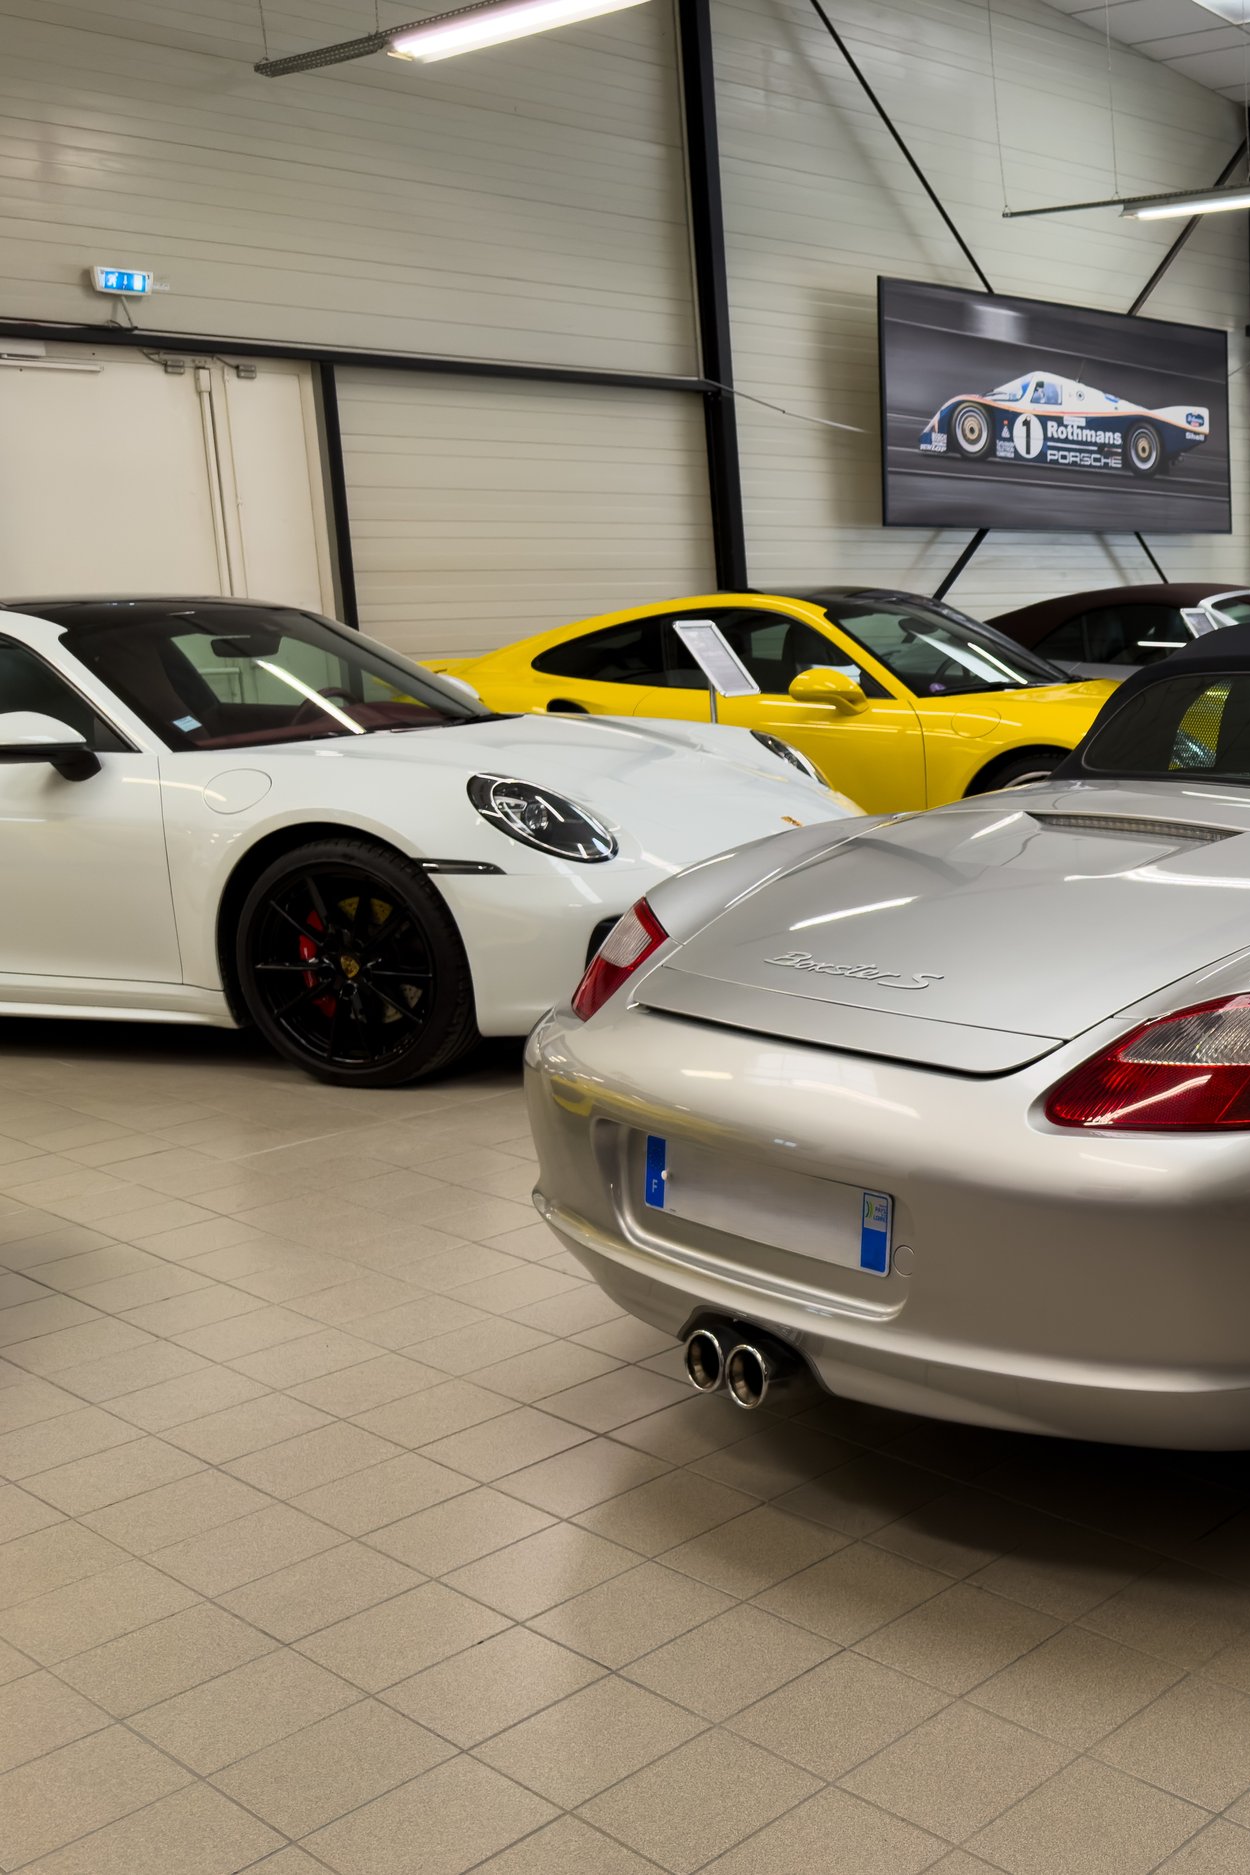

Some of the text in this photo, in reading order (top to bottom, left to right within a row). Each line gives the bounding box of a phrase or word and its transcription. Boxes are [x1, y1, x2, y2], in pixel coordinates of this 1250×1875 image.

[1022, 416, 1031, 455] 1
[1047, 421, 1122, 445] Rothmans
[1047, 450, 1122, 468] PORSCHE
[764, 951, 945, 990] Boxster S
[651, 1179, 658, 1193] F
